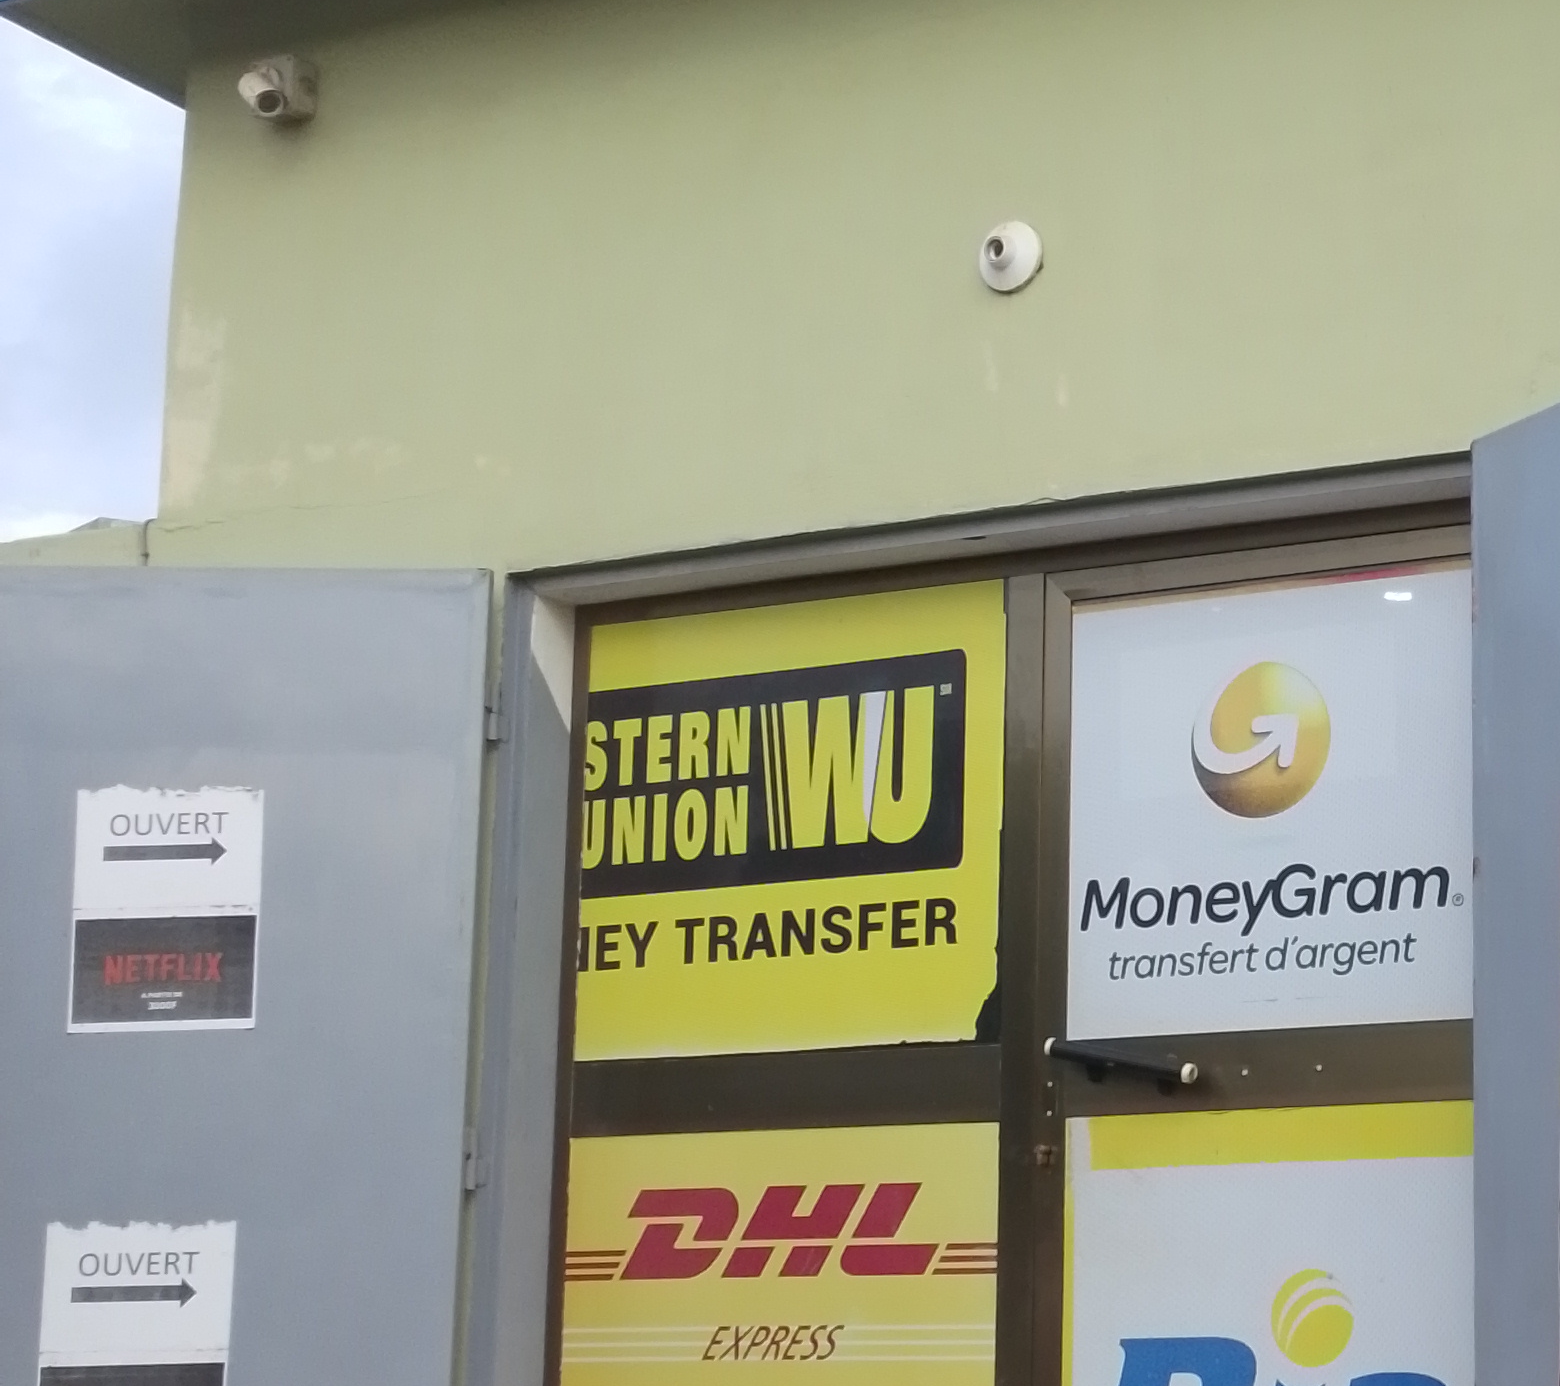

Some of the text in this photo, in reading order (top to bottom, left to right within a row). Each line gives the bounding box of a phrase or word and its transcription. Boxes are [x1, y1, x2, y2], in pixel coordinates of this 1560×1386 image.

[582, 685, 934, 871] UNION WU
[110, 812, 229, 836] OUVERT
[1080, 863, 1450, 937] MoneyGram
[675, 897, 958, 966] TRANSFER
[103, 952, 223, 986] NETFLIX
[1109, 933, 1417, 981] transfert d'argent
[620, 1182, 939, 1280] DHL
[78, 1251, 200, 1277] OUVERT
[701, 1324, 844, 1361] EXPRESS
